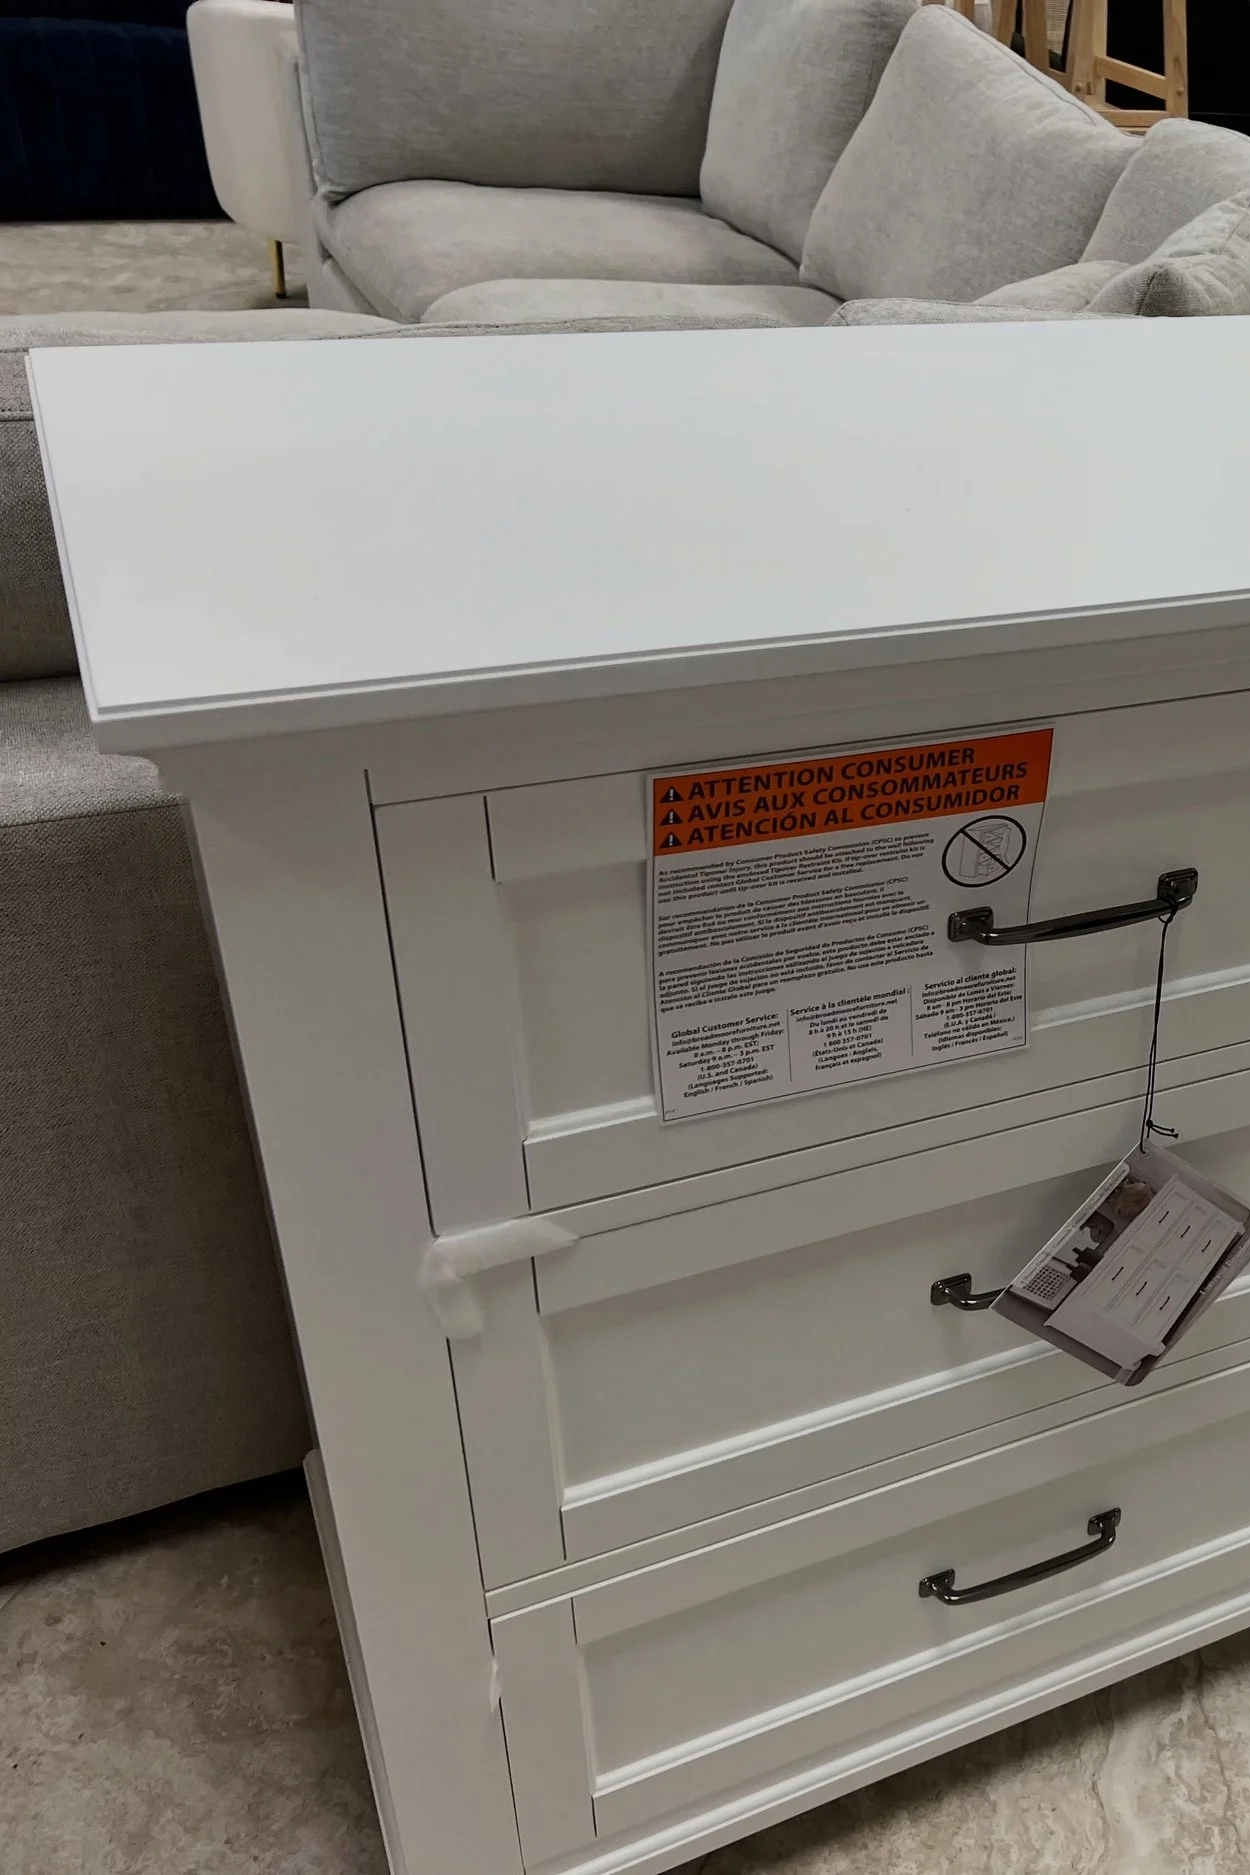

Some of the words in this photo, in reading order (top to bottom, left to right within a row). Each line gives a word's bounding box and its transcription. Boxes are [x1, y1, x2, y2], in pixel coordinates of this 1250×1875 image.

[688, 799, 745, 822] AVIS
[753, 792, 805, 813] AUX
[813, 762, 1027, 805] CONSOMMATEURS
[689, 766, 833, 800] ATTENTION
[841, 748, 975, 780] CONSUMER
[687, 812, 816, 845] ATENCIÓN
[823, 808, 853, 826] AL
[861, 785, 1019, 820] CONSUMIDOR
[924, 980, 955, 991] Servicio
[956, 976, 963, 984] al
[964, 973, 990, 983] cliente
[991, 967, 1017, 979] global:
[790, 1006, 820, 1016] Service
[837, 995, 872, 1007] clientèle
[873, 987, 906, 1000] mondial
[671, 1027, 700, 1039] Global
[702, 1020, 744, 1033] Customer
[745, 1013, 778, 1025] Service:
